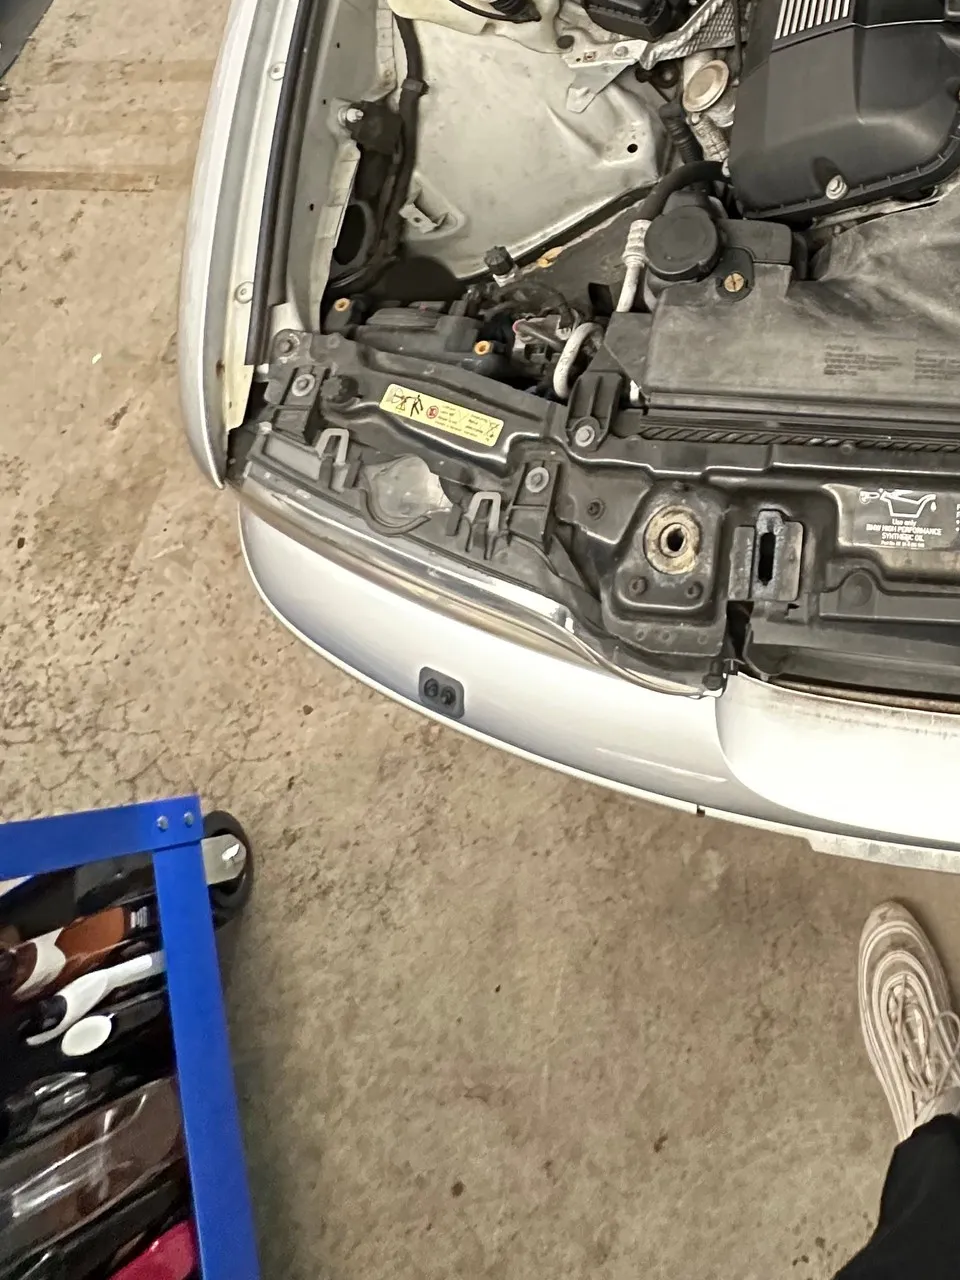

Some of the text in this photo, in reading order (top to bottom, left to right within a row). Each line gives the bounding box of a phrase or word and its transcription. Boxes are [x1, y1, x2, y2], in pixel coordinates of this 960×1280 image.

[904, 519, 917, 527] only
[866, 523, 943, 536] BMW HIGH PERFORMANCE
[881, 532, 925, 542] SYNTHETIC OIL
